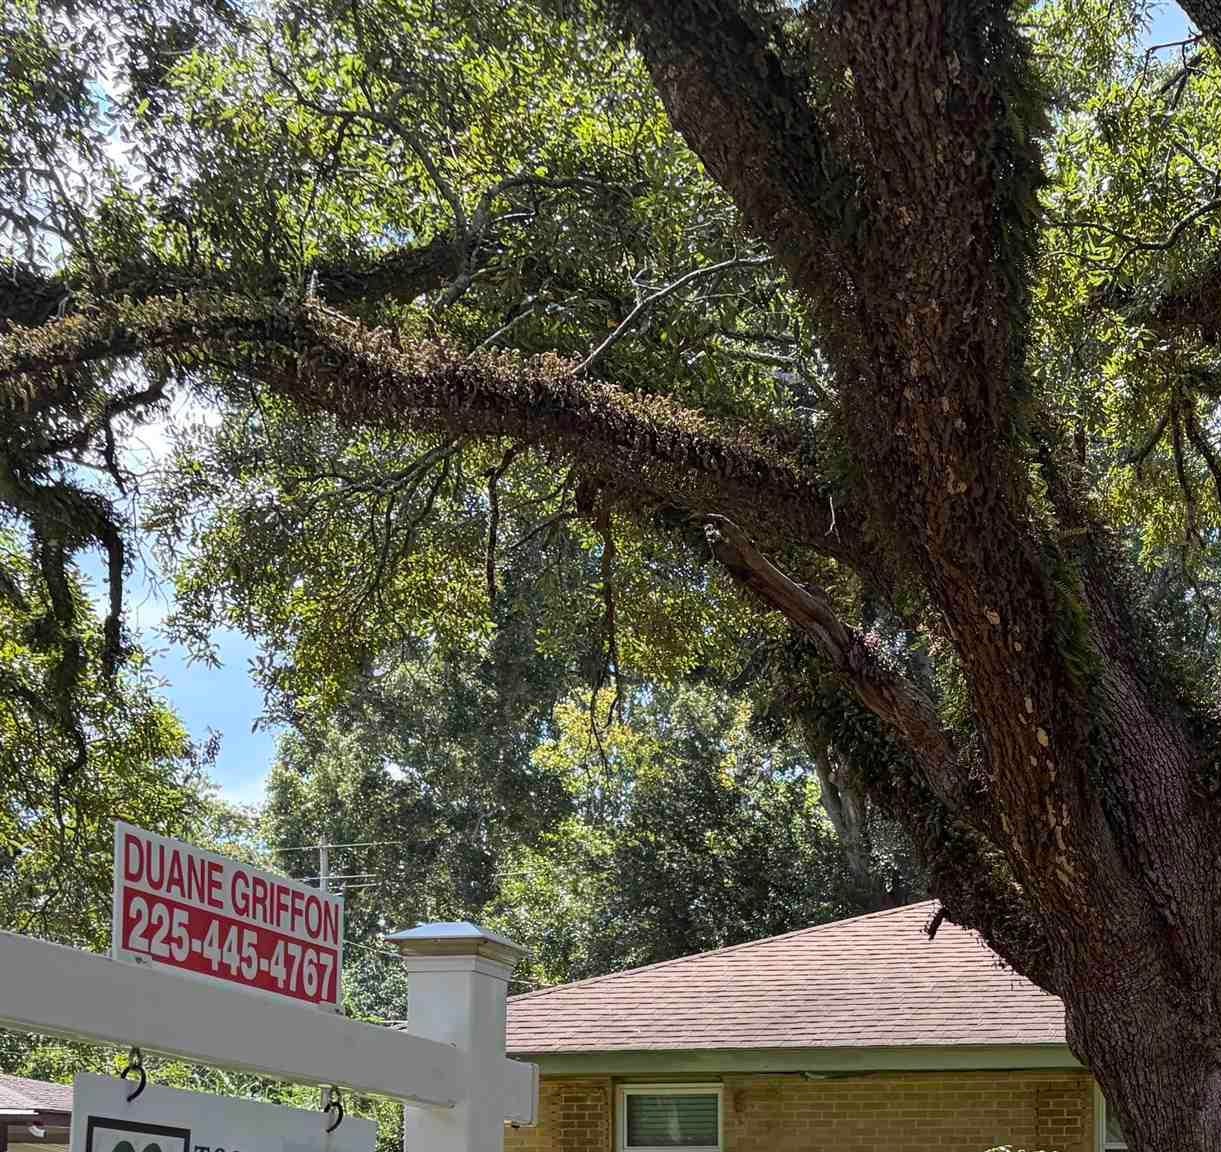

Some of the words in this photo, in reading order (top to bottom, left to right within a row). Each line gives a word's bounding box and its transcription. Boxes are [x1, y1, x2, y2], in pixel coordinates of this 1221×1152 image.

[124, 832, 224, 910] DUANE
[231, 869, 339, 946] GRIFFON
[128, 896, 334, 1000] 225-445-4767
